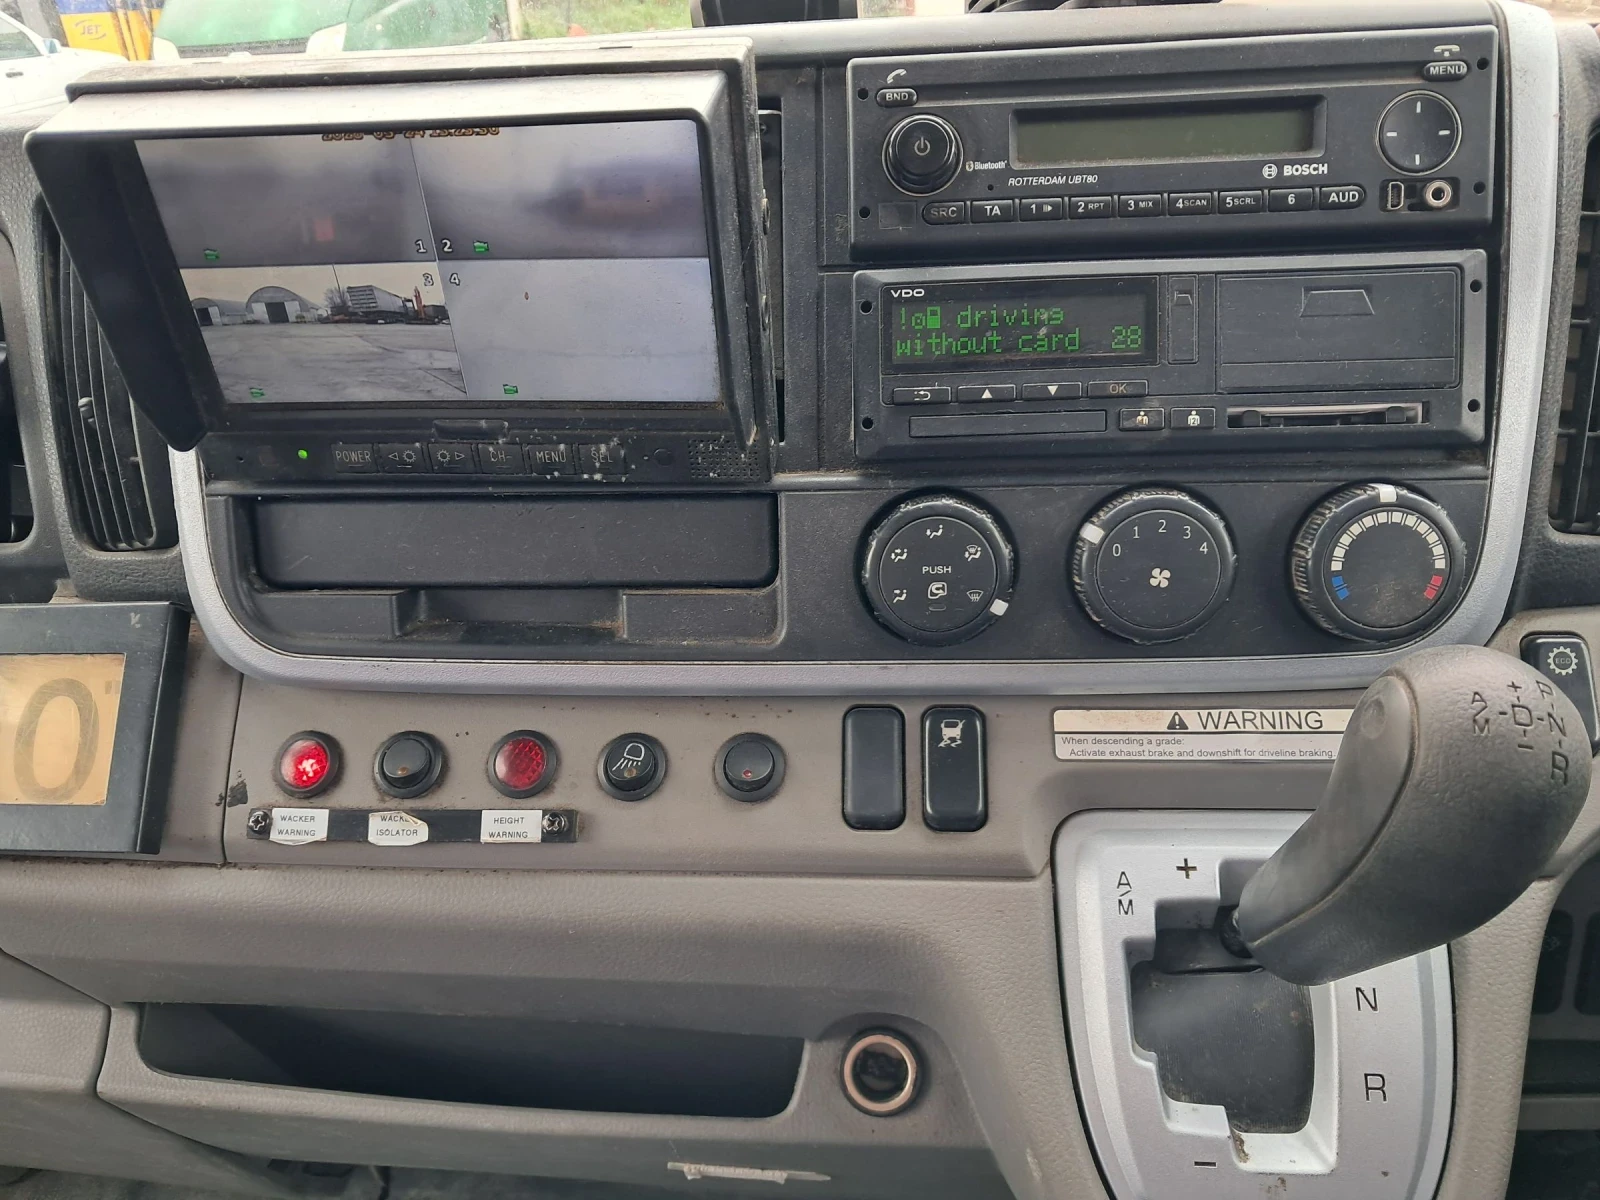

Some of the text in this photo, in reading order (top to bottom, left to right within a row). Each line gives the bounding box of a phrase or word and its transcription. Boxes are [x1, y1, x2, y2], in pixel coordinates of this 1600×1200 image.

[80, 24, 102, 36] JET
[1429, 65, 1463, 75] MENU
[885, 92, 908, 102] BND
[974, 161, 1006, 170] Bluetooth
[1283, 163, 1328, 176] BOSCH
[1008, 175, 1098, 186] ROTTERDAM UBT80
[1288, 194, 1295, 205] 6
[1328, 191, 1359, 203] AUD
[930, 207, 957, 218] SRC
[984, 205, 1001, 217] TA
[416, 240, 427, 253] 1
[441, 239, 453, 252] 2
[423, 273, 434, 286] 3
[449, 273, 461, 286] 4
[890, 289, 925, 298] VDO
[896, 325, 1142, 356] without card 28
[1109, 383, 1127, 394] OK
[336, 450, 371, 462] POWER
[536, 450, 567, 462] MENU
[591, 451, 613, 463] SEL
[1132, 526, 1140, 539] 1
[1158, 520, 1167, 533] 2
[1183, 526, 1192, 539] 3
[1112, 543, 1122, 557] 0
[1199, 542, 1209, 555] 4
[922, 566, 952, 574] PUSH
[1197, 711, 1324, 730] WARNING
[1547, 712, 1567, 737] N
[1061, 736, 1089, 745] When
[1090, 736, 1144, 748] descending
[1155, 736, 1185, 748] grade:
[1069, 748, 1336, 760] Activate exhaust brake and downshift for driveline braking.
[280, 814, 316, 823] WACKER
[493, 816, 524, 825] HEIGHT
[277, 828, 316, 837] WARNING
[376, 828, 418, 836] ISOLATOR
[488, 830, 529, 839] WARNING
[1355, 987, 1379, 1012] N
[1364, 1073, 1387, 1102] R
